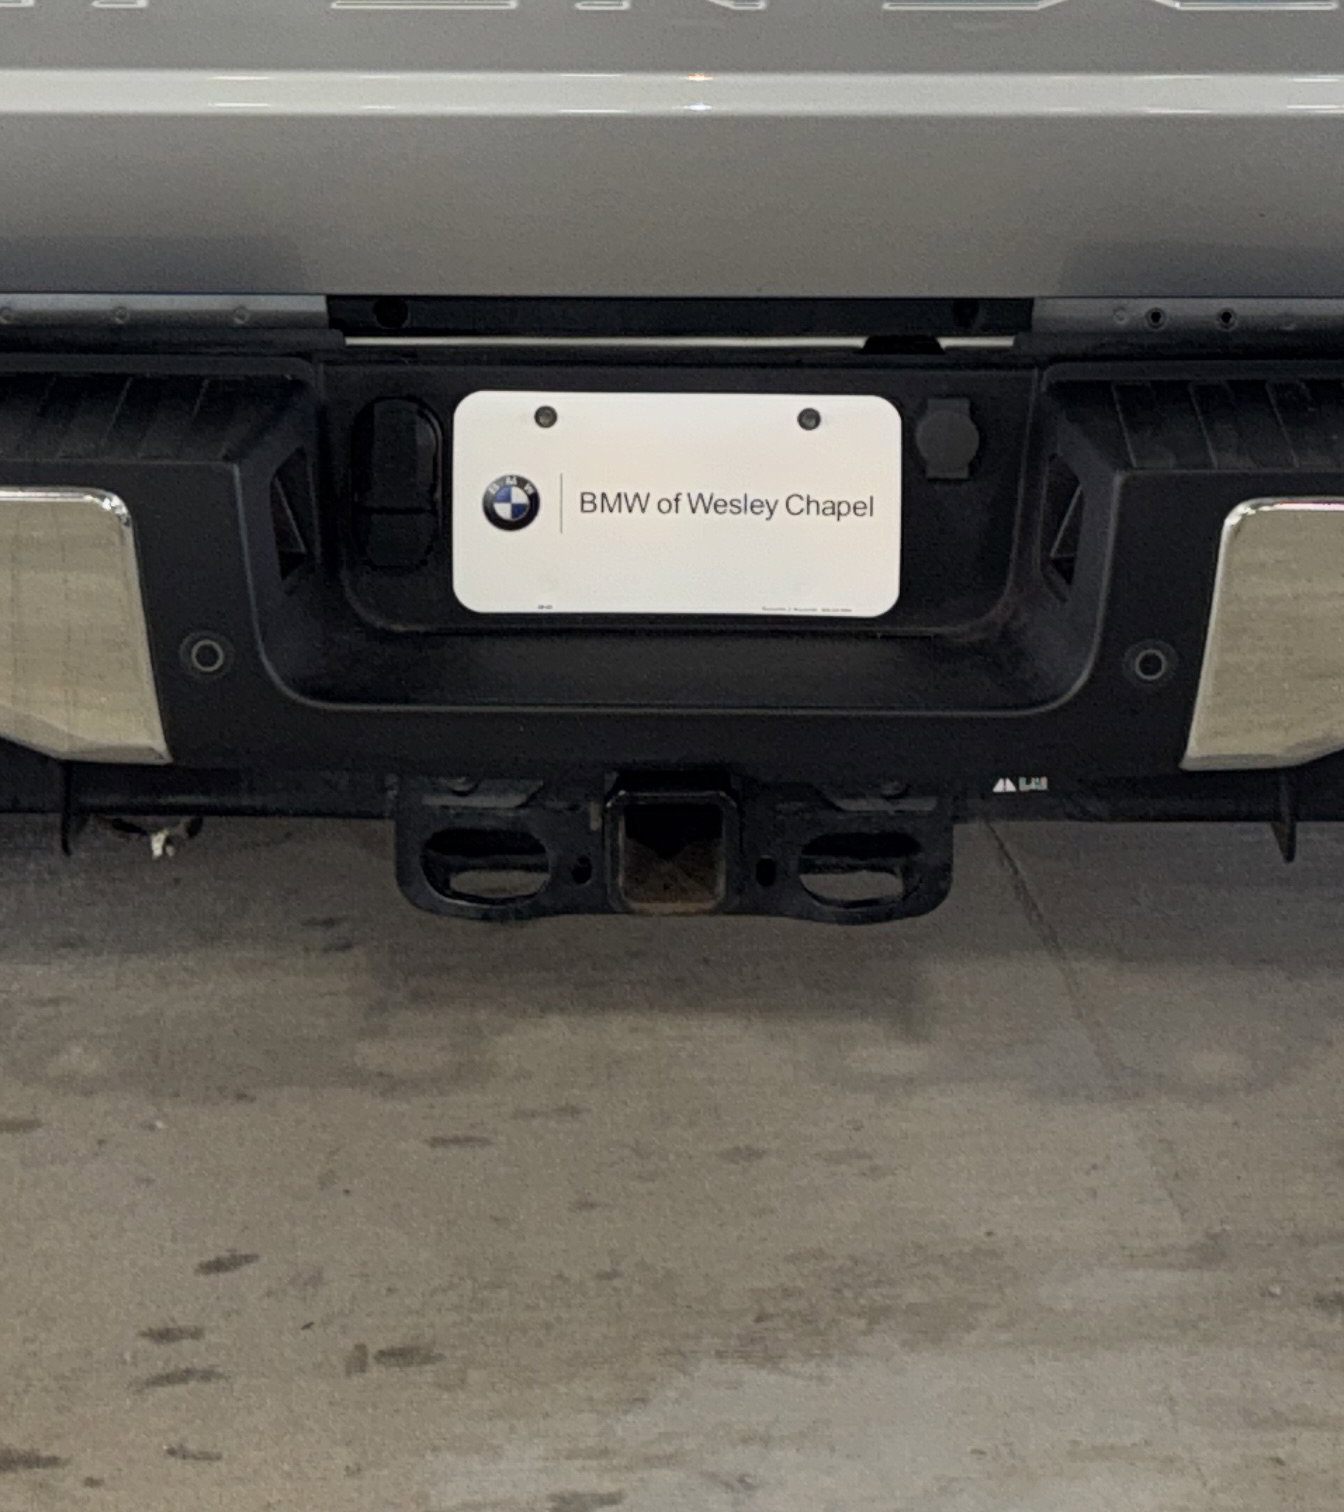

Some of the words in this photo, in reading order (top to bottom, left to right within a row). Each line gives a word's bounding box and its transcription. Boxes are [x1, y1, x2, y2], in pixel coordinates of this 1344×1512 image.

[580, 491, 650, 513] BMW
[657, 492, 681, 514] of
[687, 492, 778, 521] Wesley
[785, 493, 874, 522] Chapel
